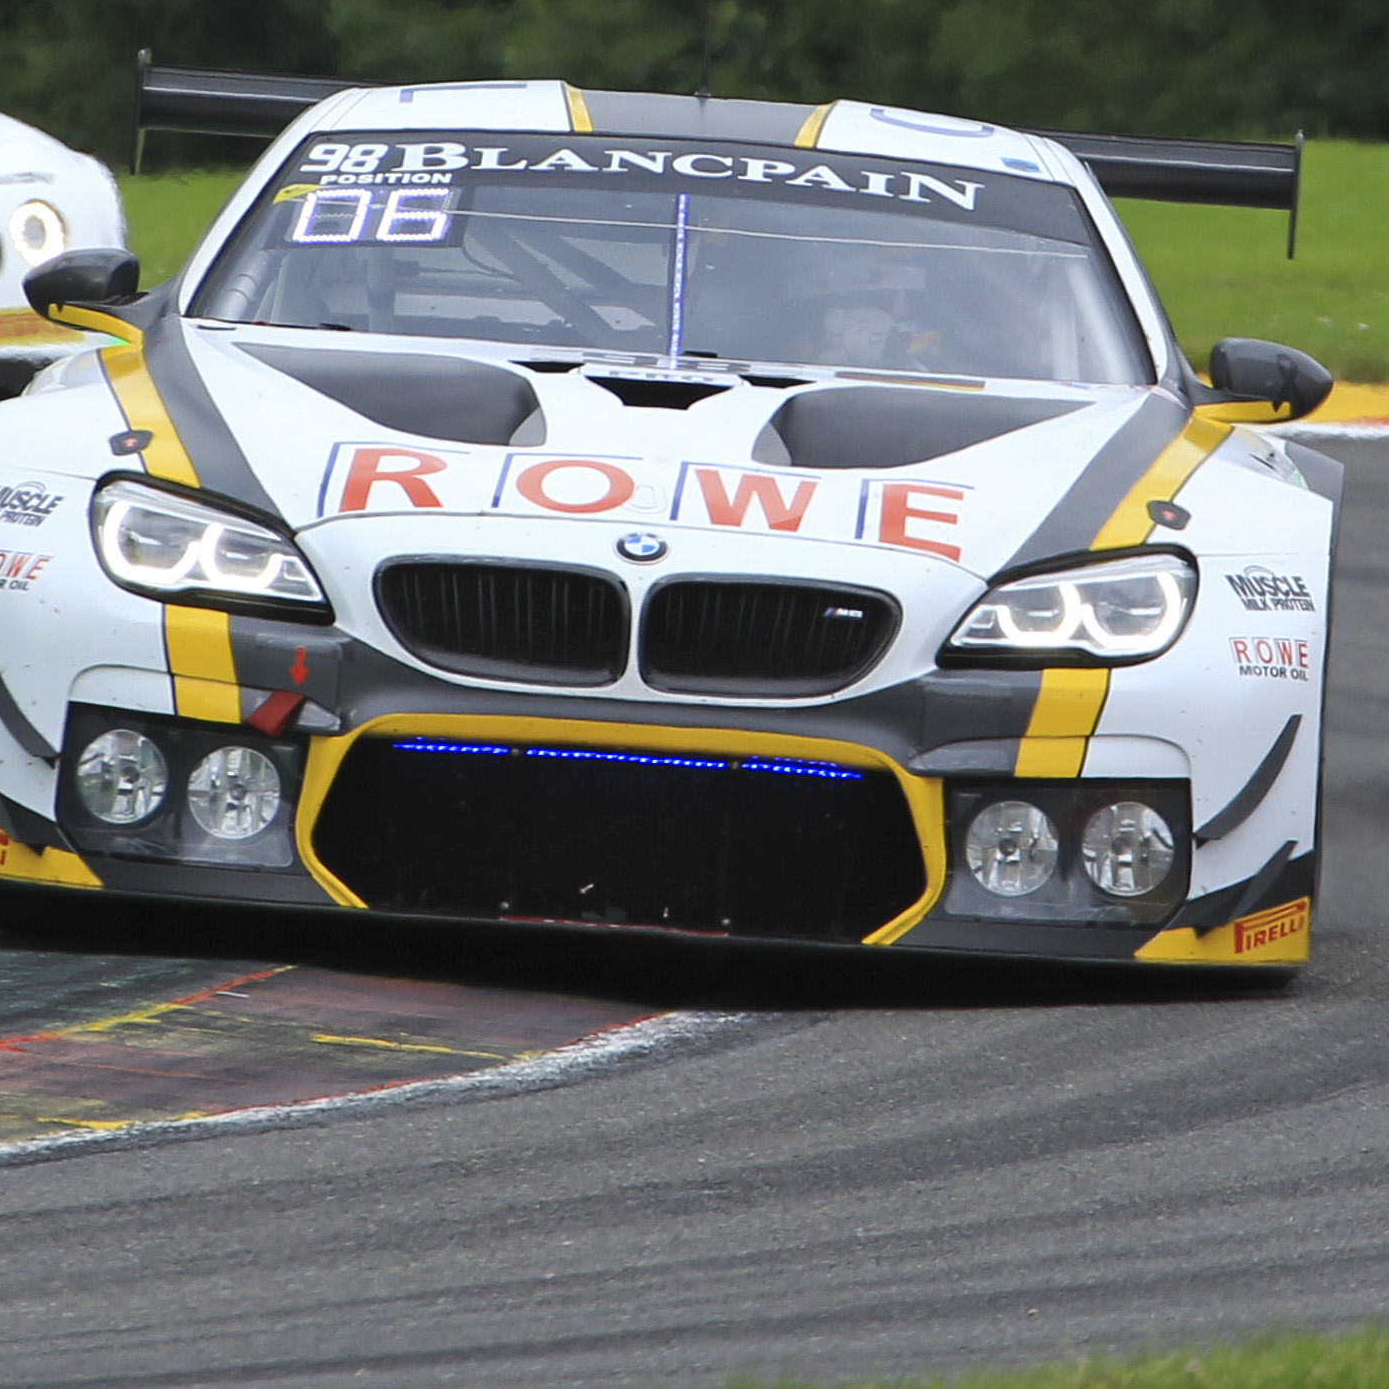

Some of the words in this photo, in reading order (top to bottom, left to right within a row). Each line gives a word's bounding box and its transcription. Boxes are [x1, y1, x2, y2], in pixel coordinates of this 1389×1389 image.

[299, 143, 389, 173] 98
[390, 142, 985, 211] BLANCPAIN
[319, 173, 453, 186] POSITION
[291, 187, 452, 243] 06
[338, 447, 966, 563] ROWE
[9, 579, 30, 591] OIL
[1224, 574, 1311, 598] MUSCLE
[1231, 638, 1309, 669] ROWE
[1239, 665, 1288, 679] MOTOR
[1290, 667, 1309, 682] OIL
[1234, 900, 1307, 955] PIRELLI
